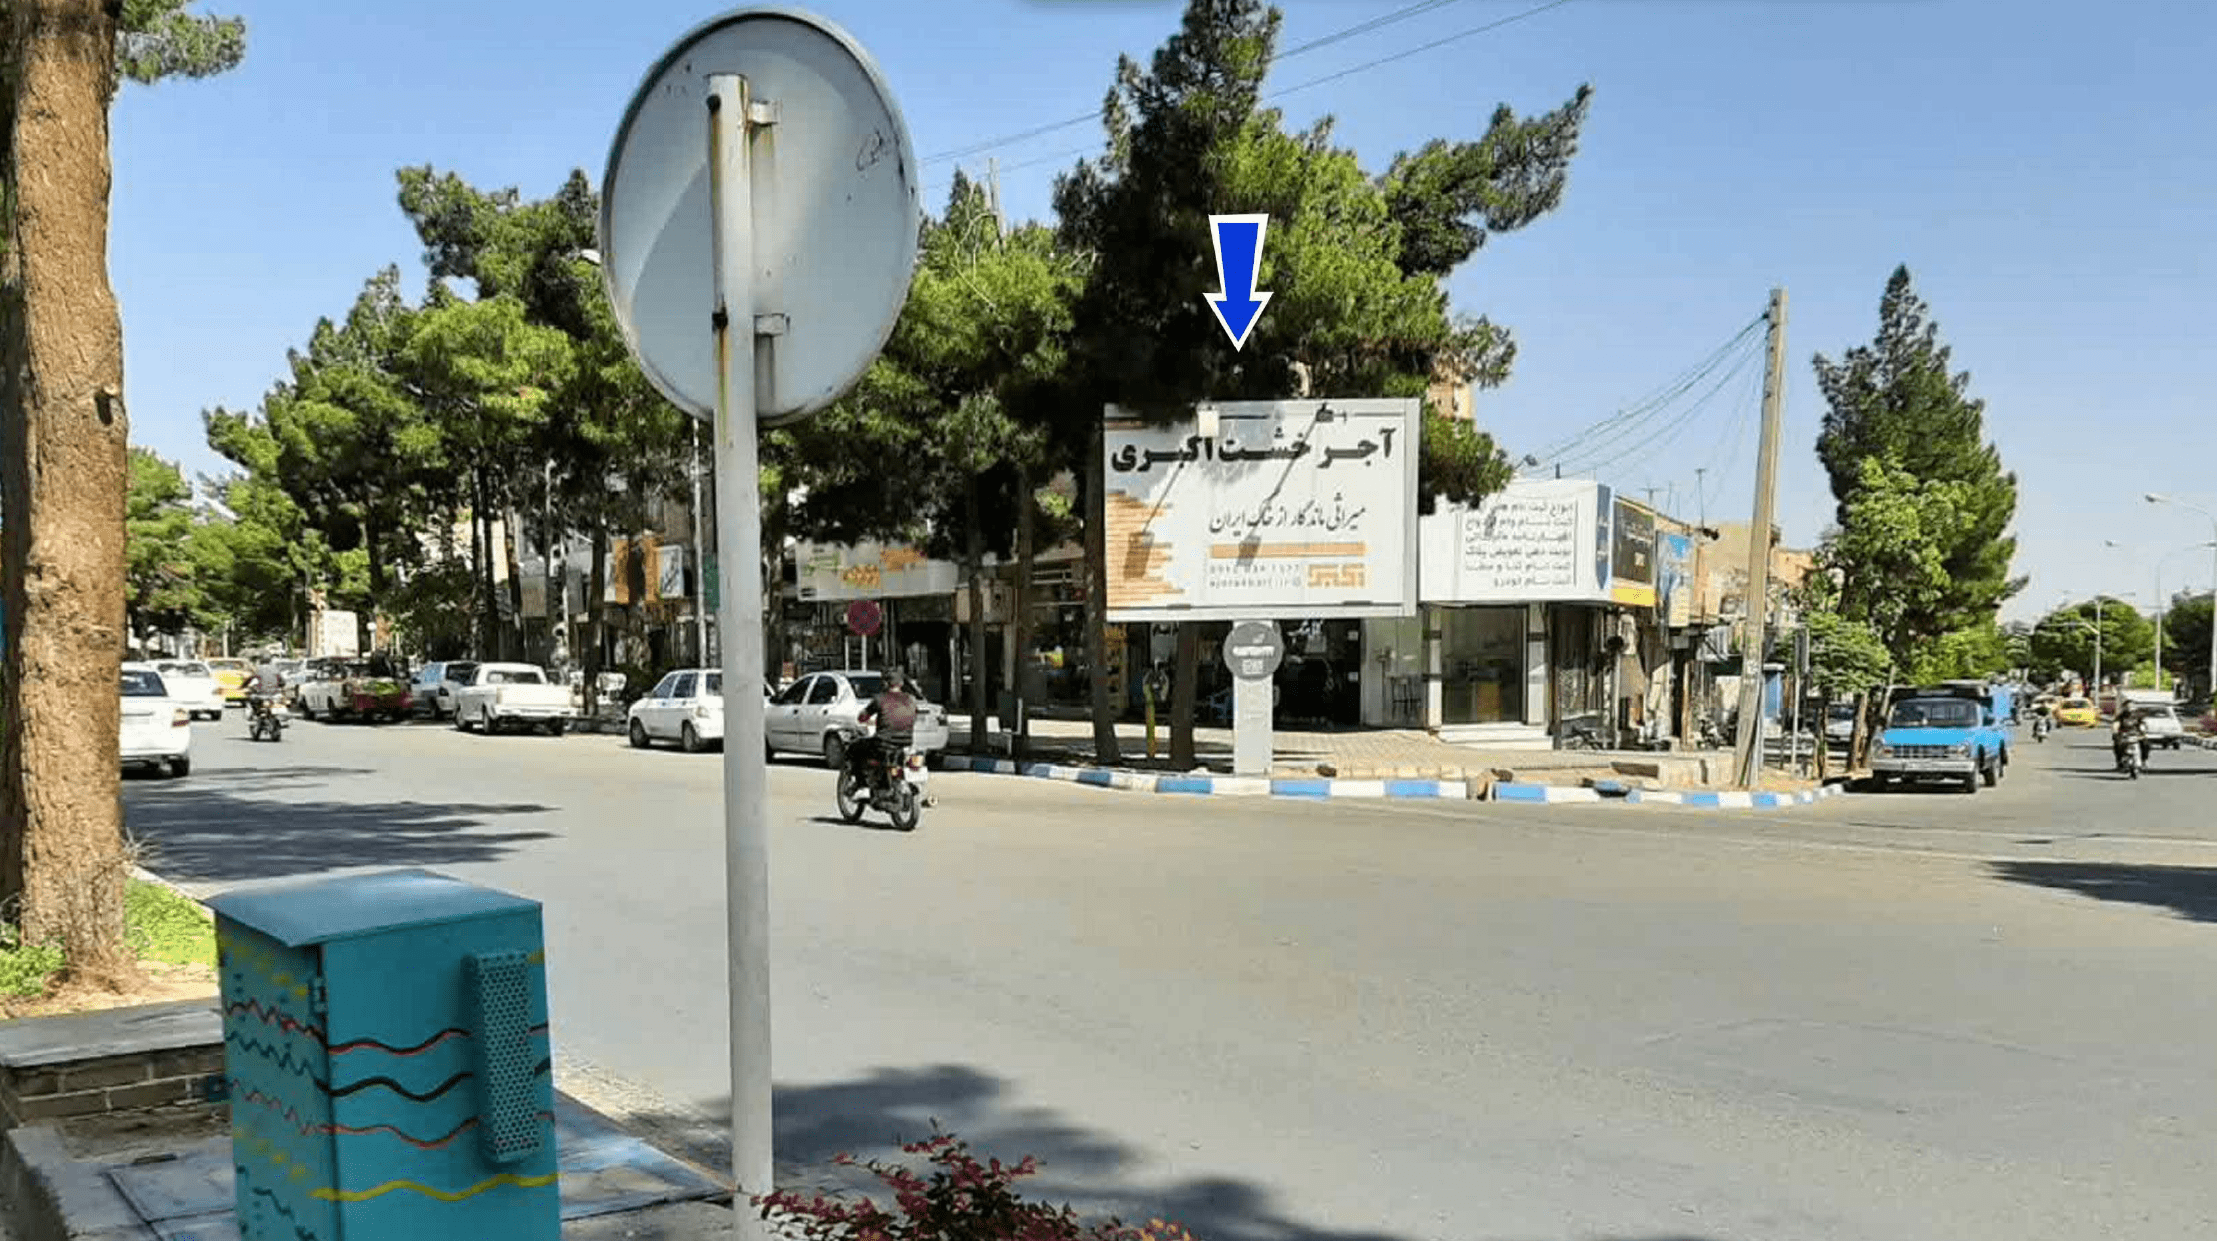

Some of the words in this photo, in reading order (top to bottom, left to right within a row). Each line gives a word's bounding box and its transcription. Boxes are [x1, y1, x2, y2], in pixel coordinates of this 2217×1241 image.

[1111, 436, 1212, 472] اکبری
[1219, 427, 1311, 462] خشت
[1316, 428, 1397, 468] آجر
[1209, 510, 1246, 537] ایران
[1247, 504, 1274, 527] خاک
[1276, 506, 1287, 527] از
[1290, 500, 1325, 527] ماندگار
[1326, 492, 1366, 531] میراثی
